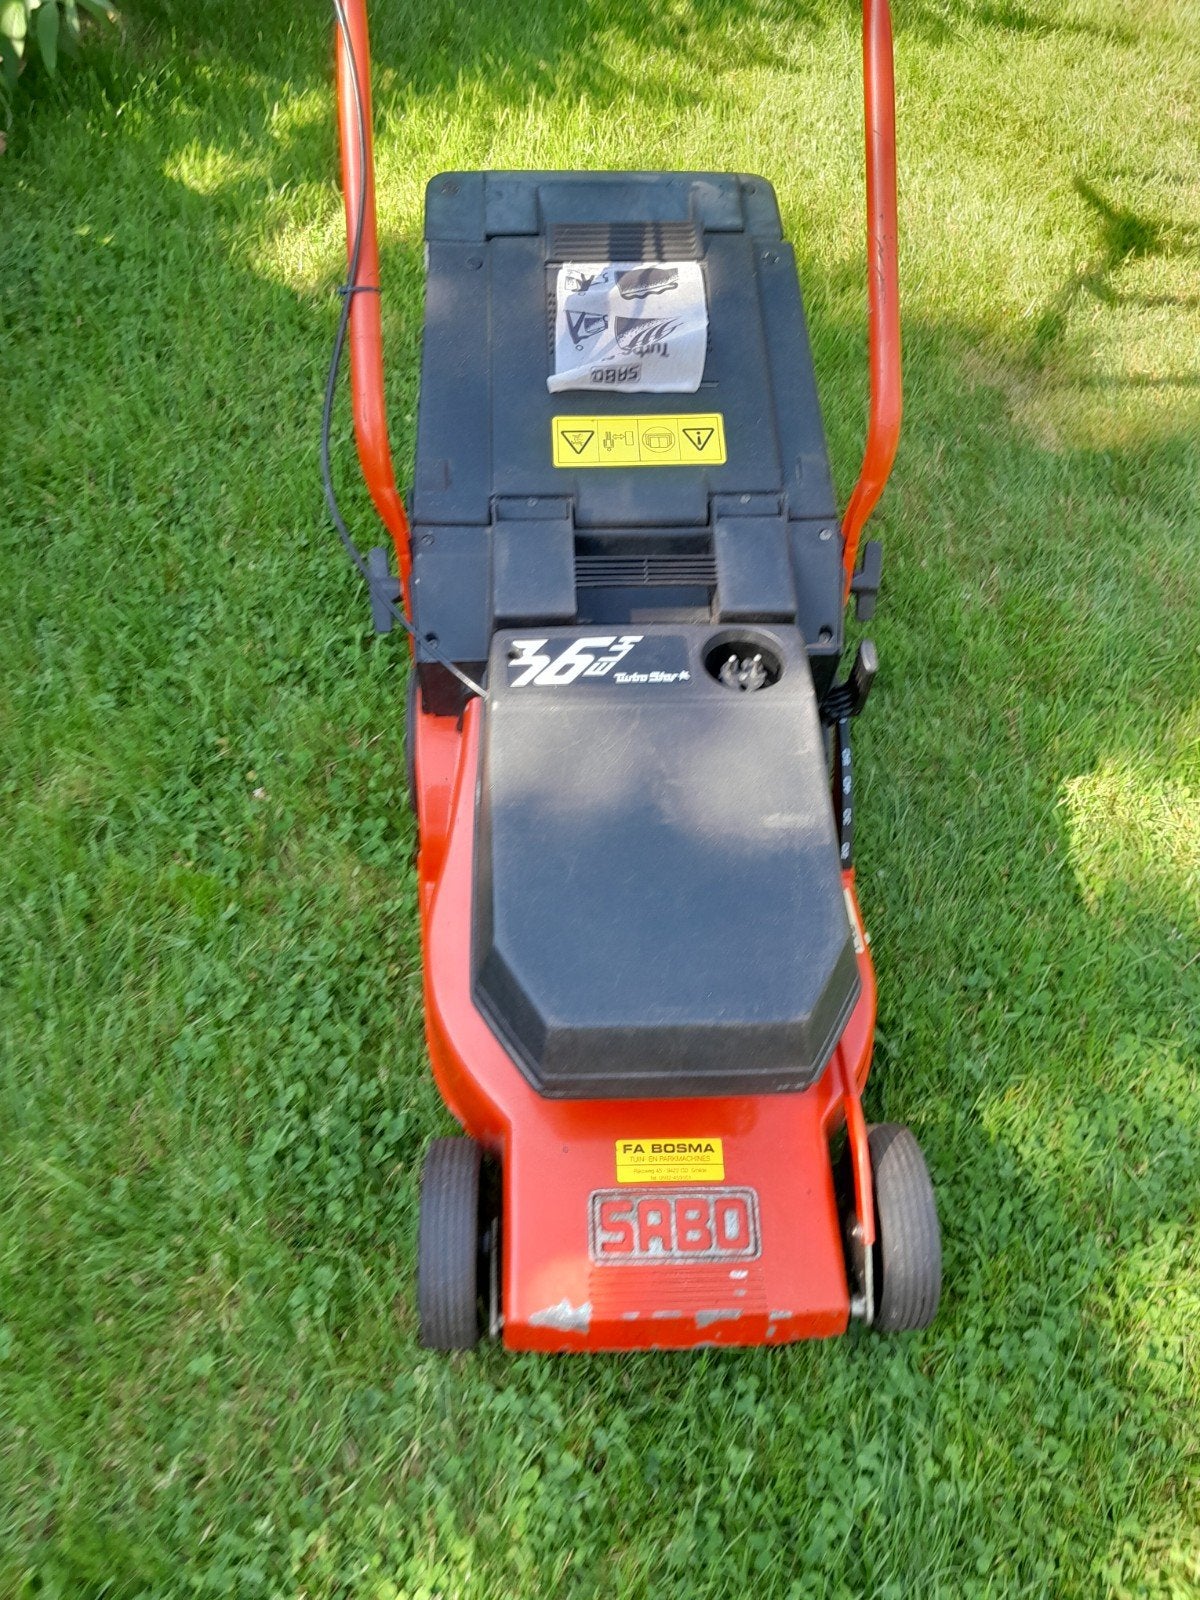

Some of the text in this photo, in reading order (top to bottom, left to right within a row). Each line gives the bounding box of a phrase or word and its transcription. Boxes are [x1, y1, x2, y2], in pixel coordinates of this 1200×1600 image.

[508, 636, 617, 687] 36
[613, 671, 679, 684] Turbo Star
[622, 1143, 715, 1153] FA BOSMA
[601, 1198, 750, 1253] SABO
